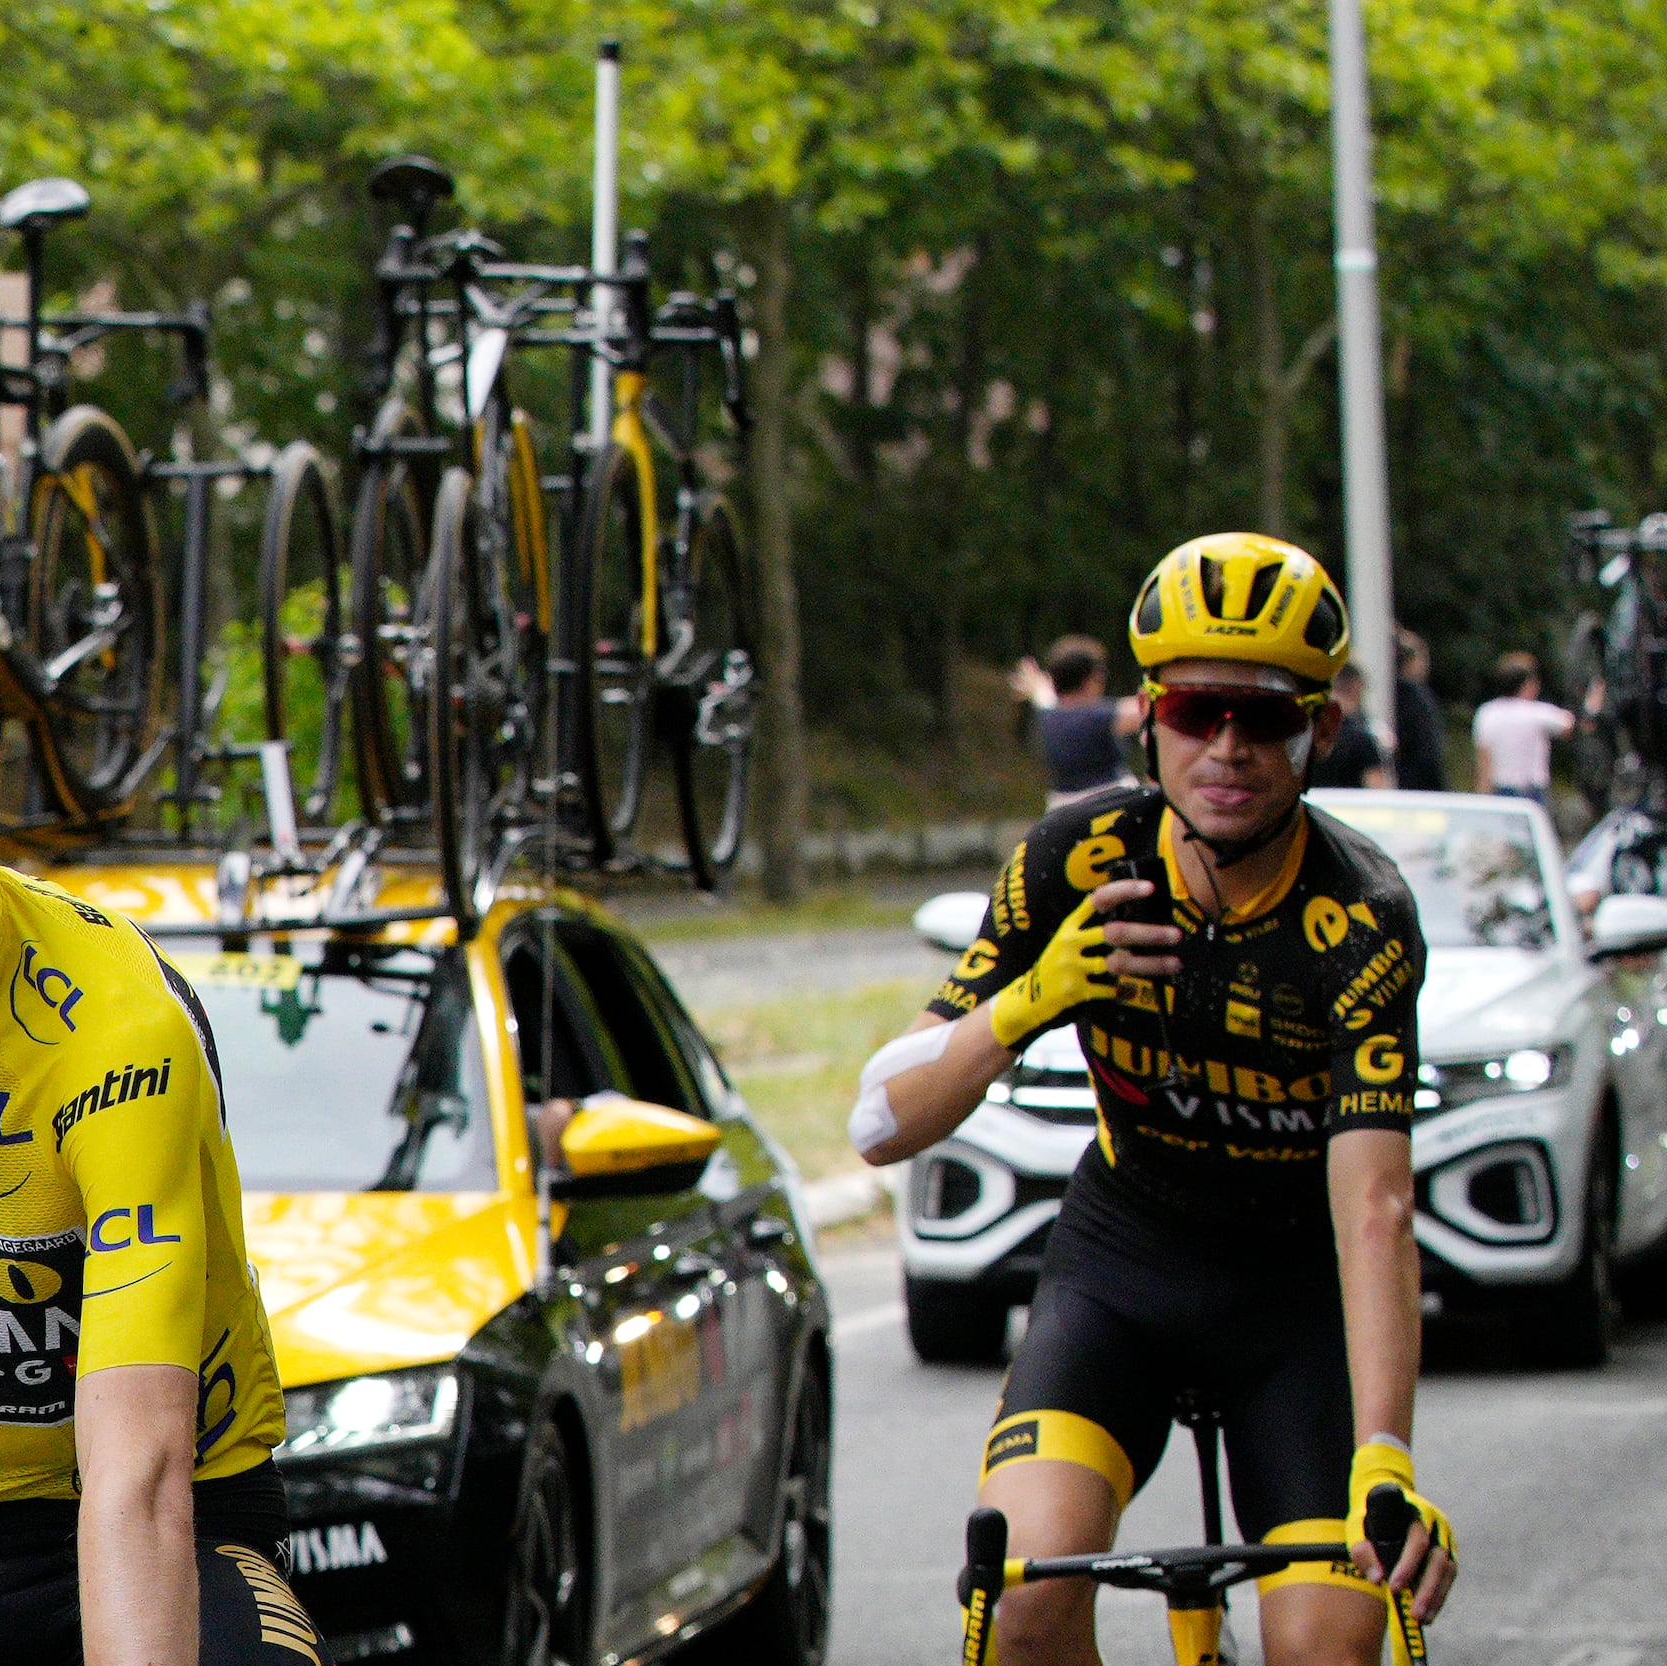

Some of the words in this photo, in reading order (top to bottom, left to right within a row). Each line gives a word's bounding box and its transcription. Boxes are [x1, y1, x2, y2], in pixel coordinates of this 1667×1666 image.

[22, 945, 84, 1033] LCL
[1334, 939, 1404, 1020] JUMBO
[1166, 1089, 1332, 1134] VISM
[84, 1204, 181, 1255] CL
[14, 1359, 52, 1386] G
